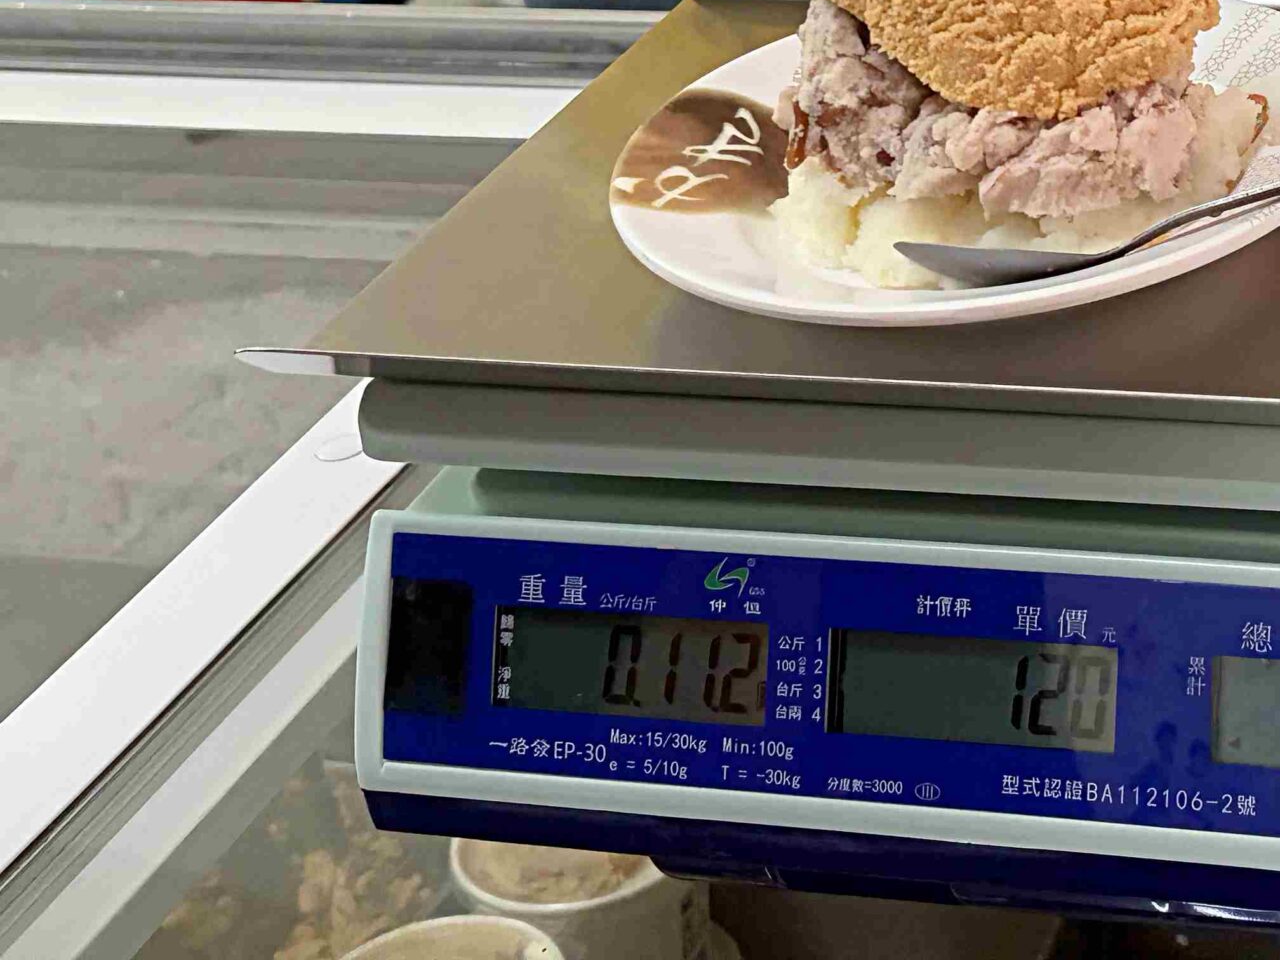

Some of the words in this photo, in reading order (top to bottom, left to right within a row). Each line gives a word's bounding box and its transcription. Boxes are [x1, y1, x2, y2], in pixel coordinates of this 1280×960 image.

[517, 574, 587, 606] 重量
[599, 593, 657, 613] 公斤/台斤
[1013, 605, 1088, 639] 單價
[1102, 627, 1117, 643] 元
[778, 635, 806, 652] 公斤
[816, 636, 822, 652] 1
[776, 659, 797, 673] 100
[814, 659, 823, 675] 2
[776, 681, 804, 699] 台斤
[812, 683, 822, 700] 3
[1010, 652, 1113, 740] 120
[811, 706, 822, 723] 4
[609, 728, 708, 753] Max:15/30kg
[722, 736, 795, 761] Min:100g
[643, 758, 688, 780] 5/10g
[721, 765, 731, 781] T
